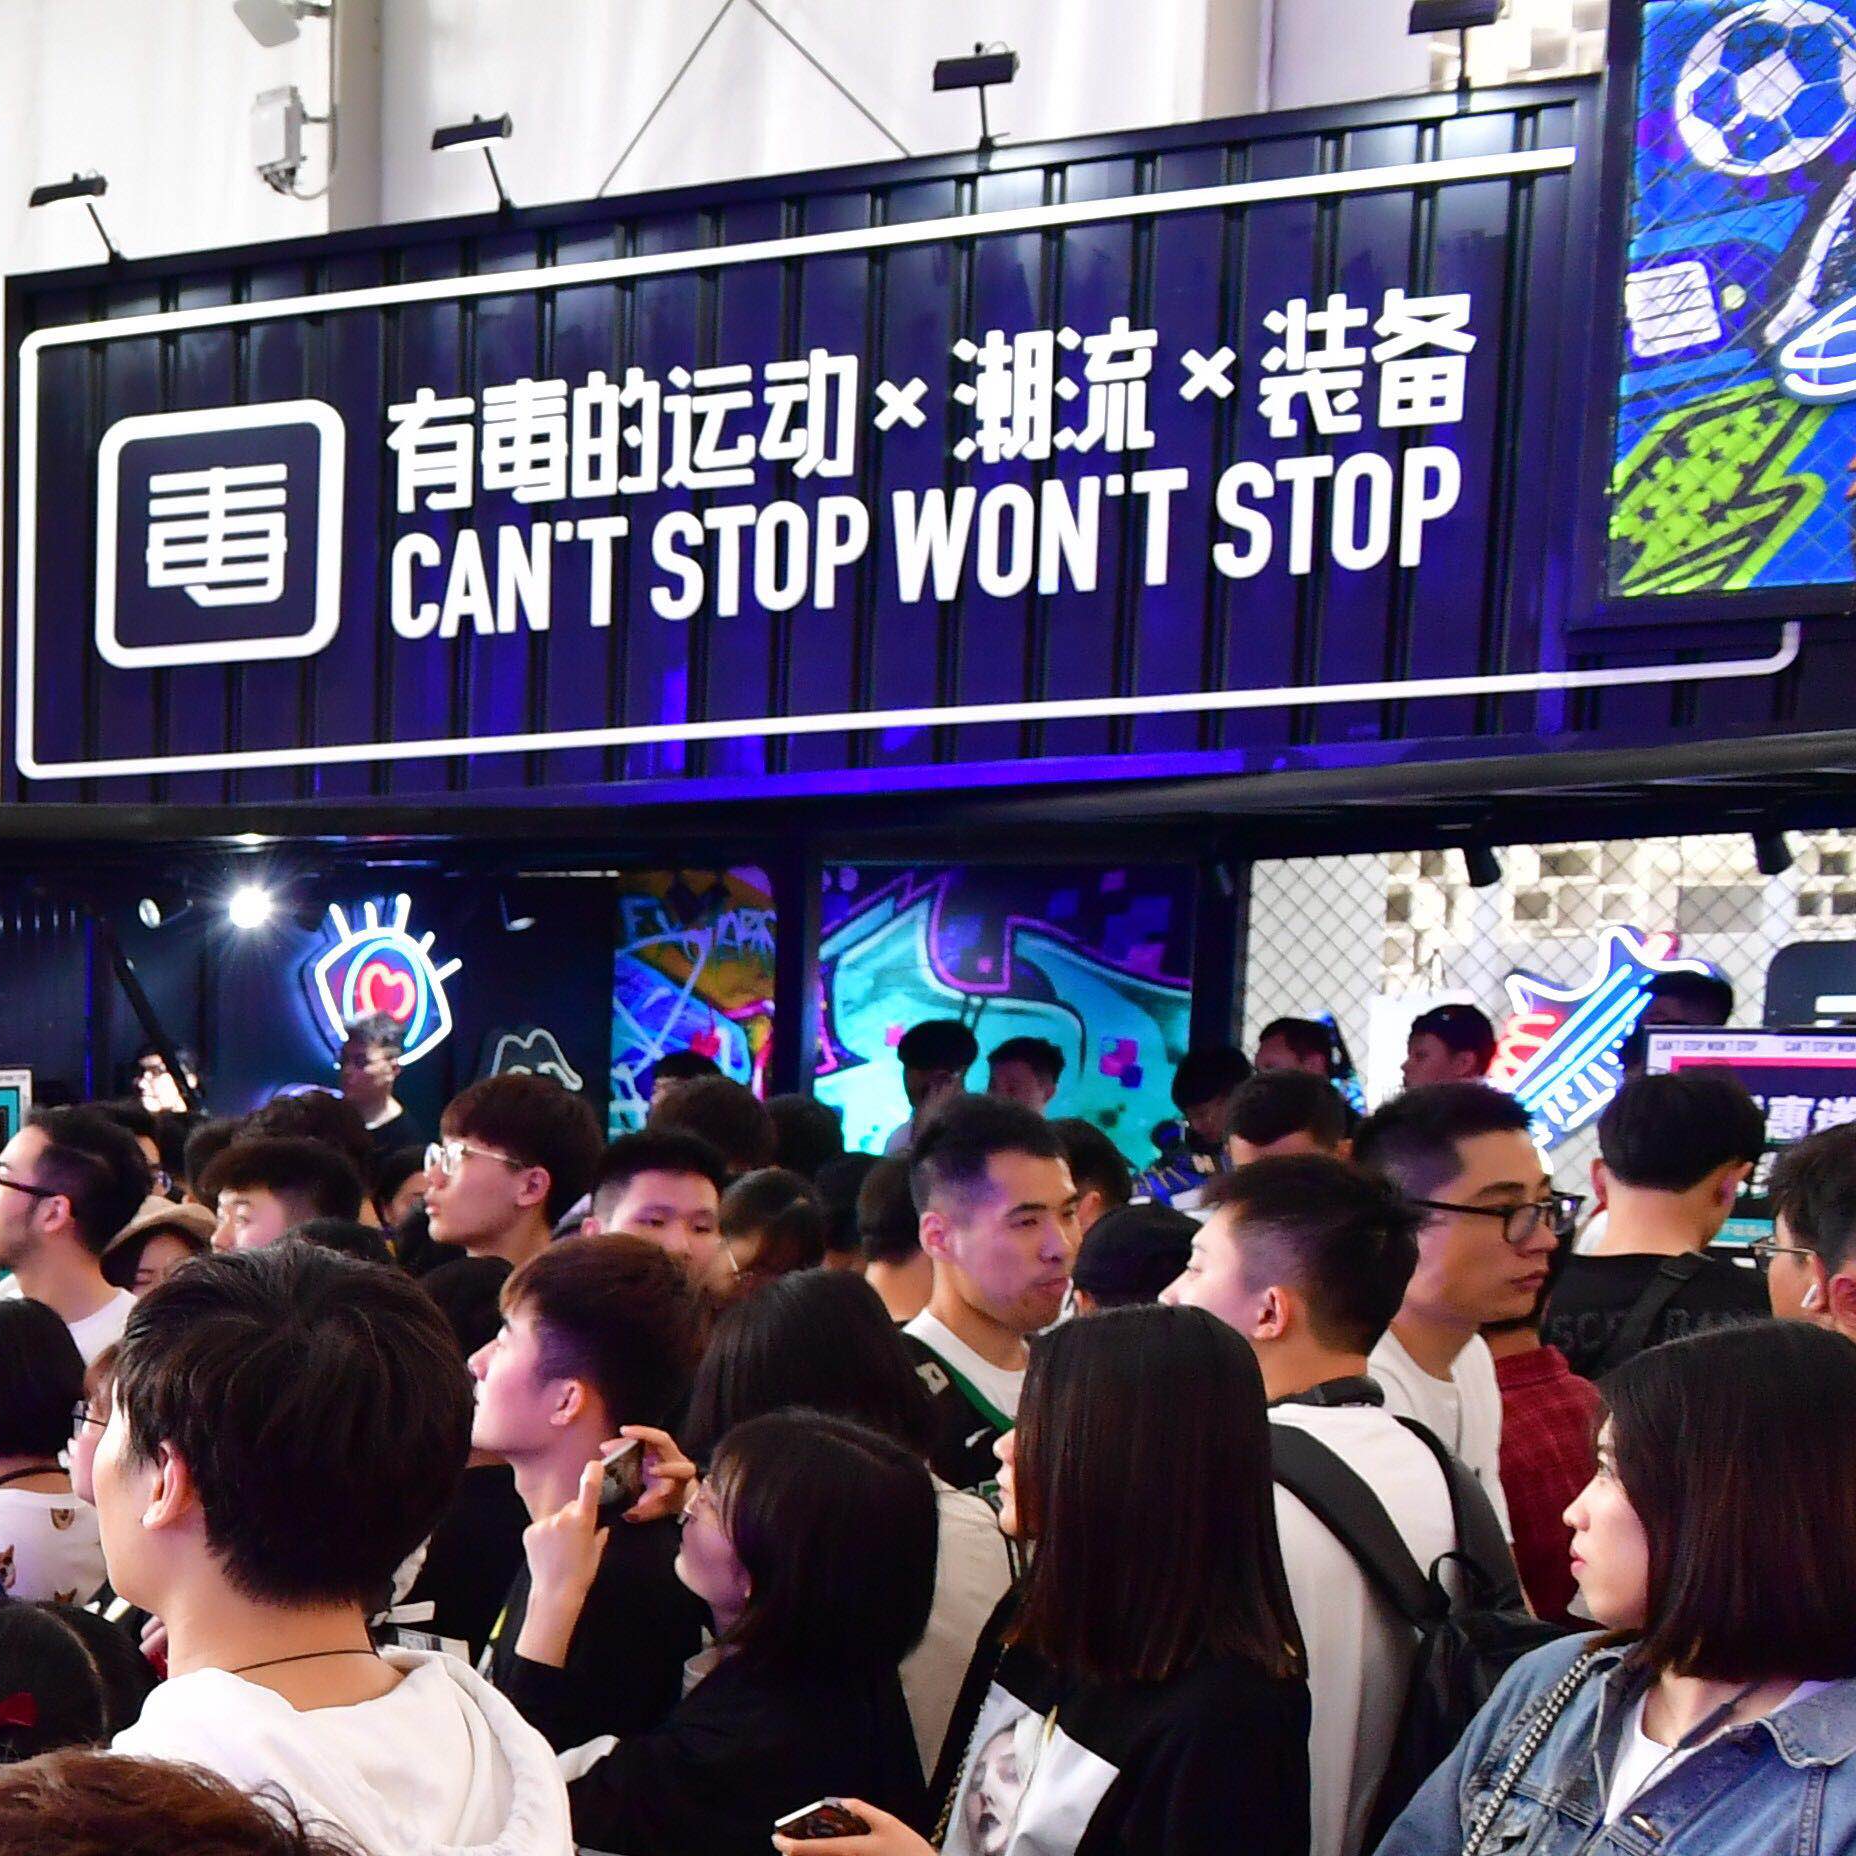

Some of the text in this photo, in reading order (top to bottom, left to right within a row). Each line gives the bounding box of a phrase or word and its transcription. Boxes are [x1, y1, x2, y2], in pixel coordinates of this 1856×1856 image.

[391, 447, 1461, 638] CAN'T STOP WON'T STOP
